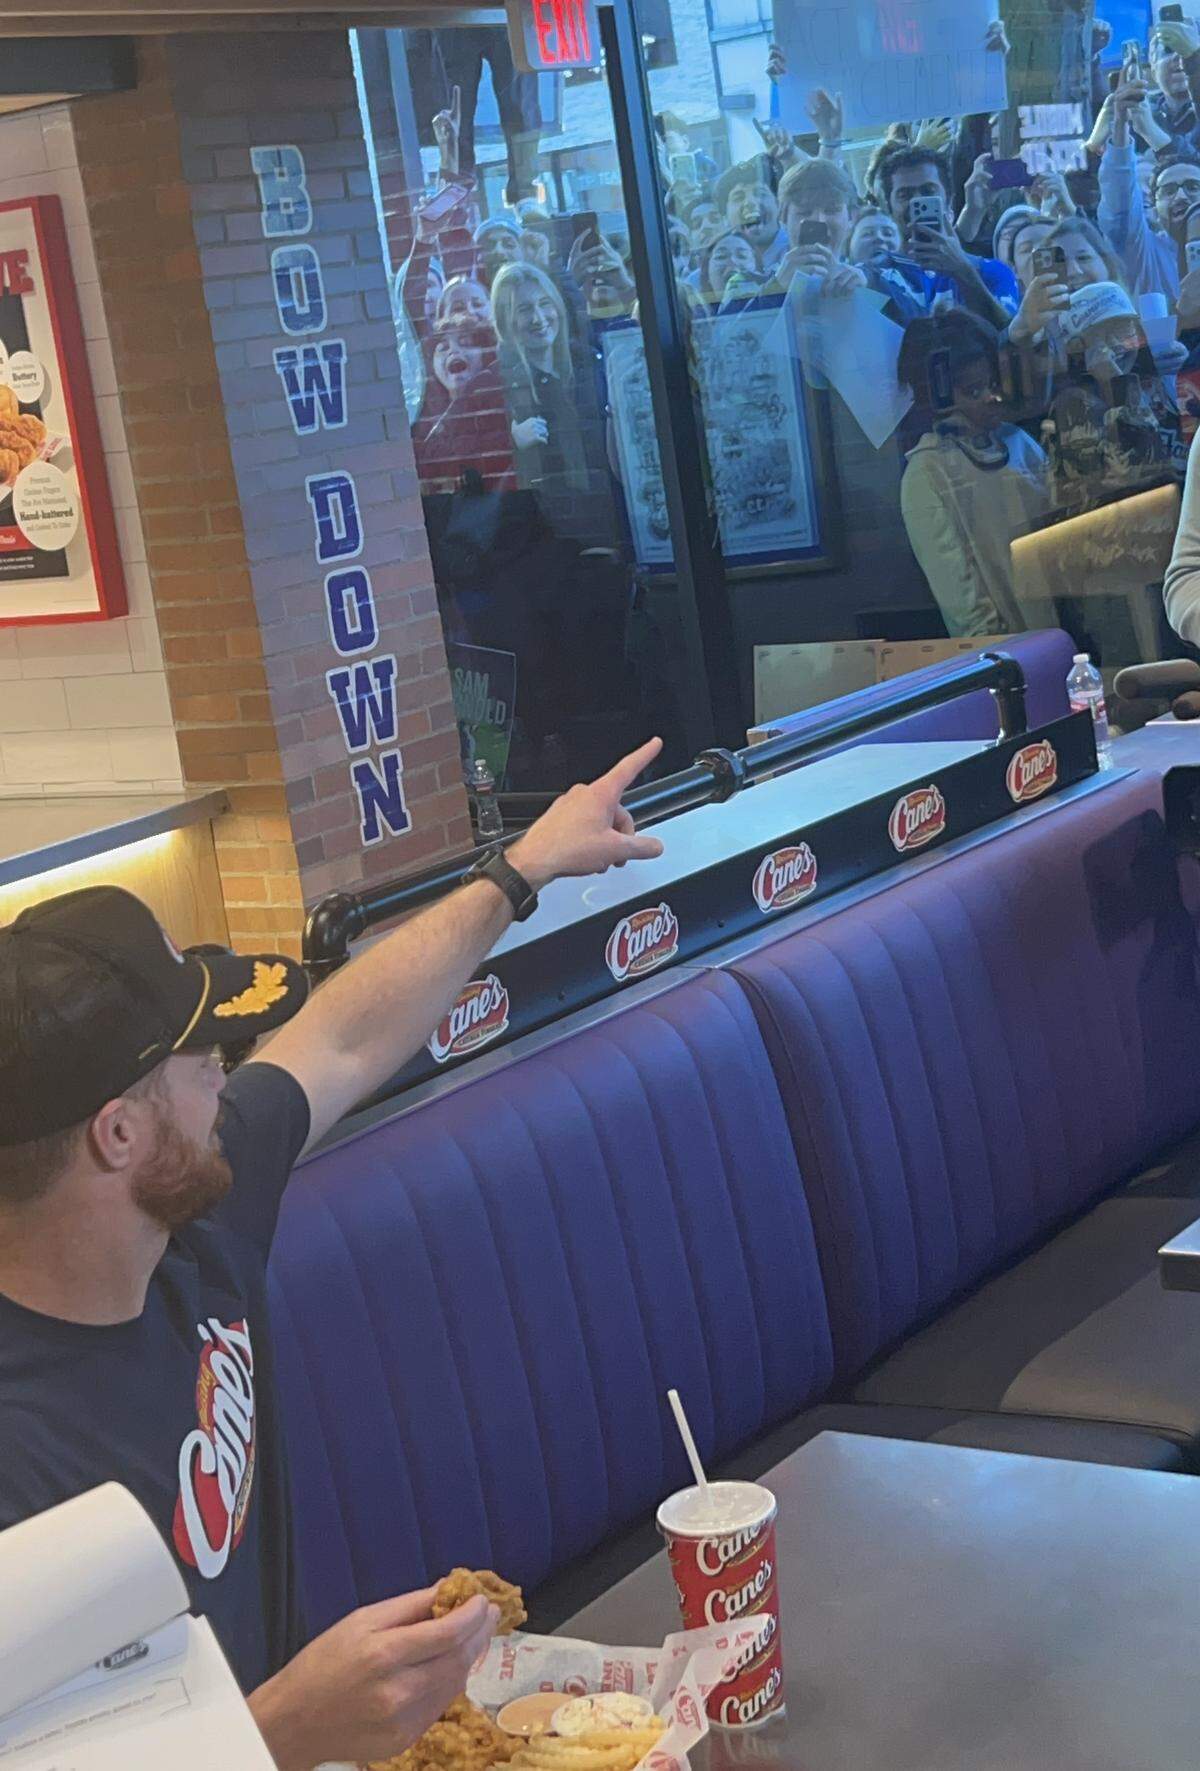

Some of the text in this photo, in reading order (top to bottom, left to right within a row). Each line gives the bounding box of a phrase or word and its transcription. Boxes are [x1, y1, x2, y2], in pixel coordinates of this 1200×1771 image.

[249, 144, 413, 847] BOW DOWN
[1008, 740, 1056, 801] Cane's
[892, 785, 944, 850] Cane's
[757, 843, 815, 910] Cane's
[610, 904, 676, 978] Cane's
[178, 1317, 254, 1580] Cane's
[704, 1559, 773, 1625] Cane's
[720, 1666, 782, 1724] Cane's
